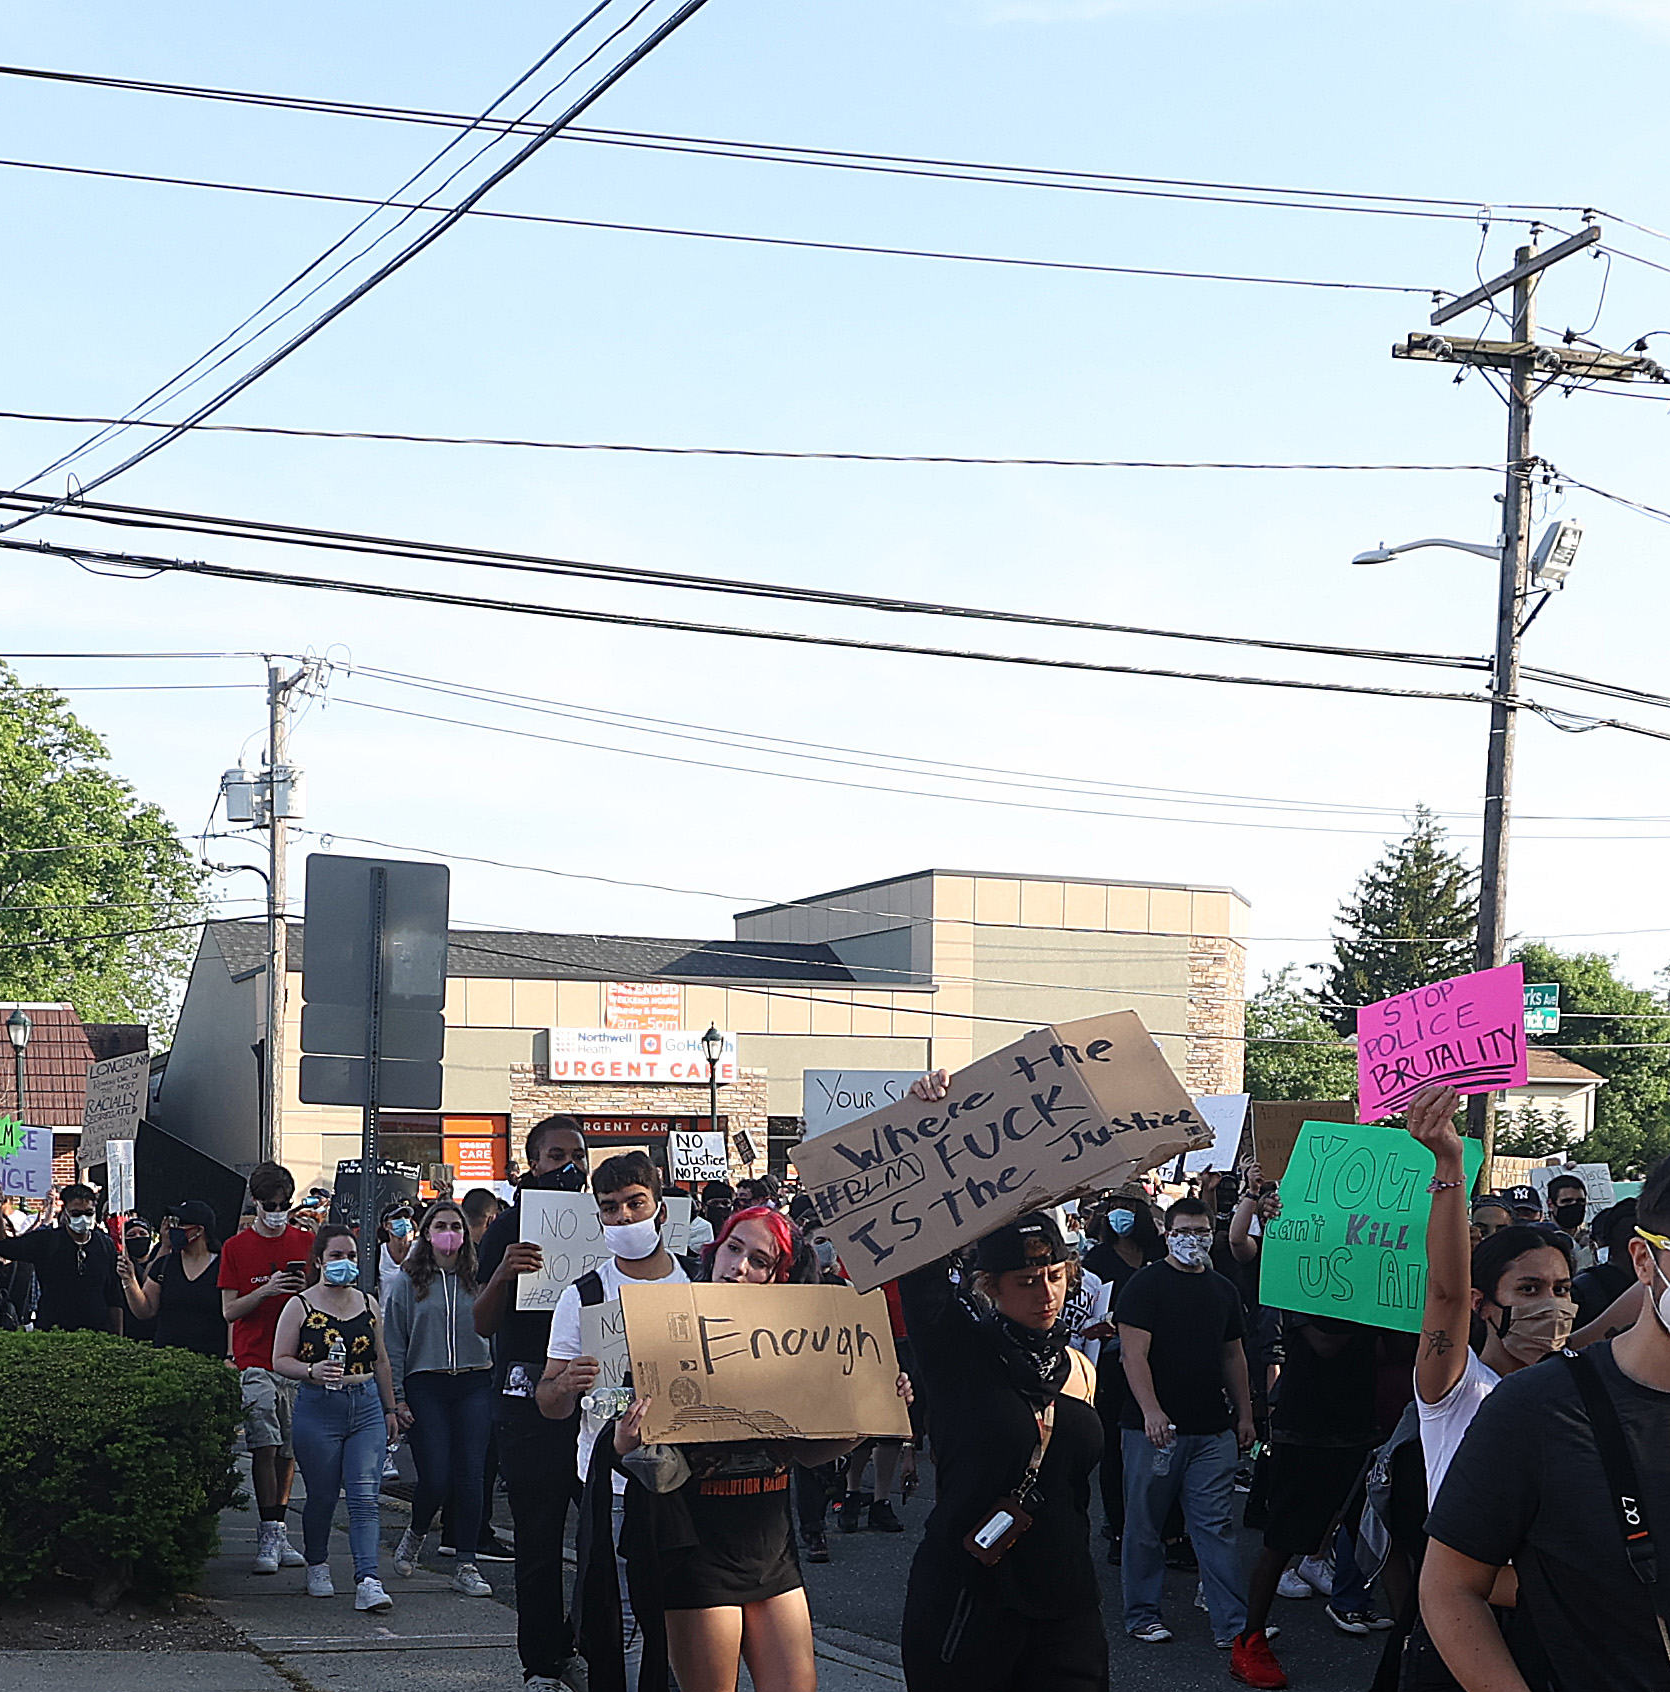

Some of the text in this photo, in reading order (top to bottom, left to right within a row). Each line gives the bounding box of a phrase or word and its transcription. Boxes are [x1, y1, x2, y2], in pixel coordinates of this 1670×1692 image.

[1383, 982, 1455, 1027] STOP
[578, 1032, 632, 1043] Northwell
[665, 1038, 734, 1052] GoHeh
[1364, 1002, 1480, 1062] POLICE
[578, 1044, 612, 1055] Health
[1369, 1023, 1518, 1096] BRUTALITY
[554, 1060, 658, 1077] URGENT
[85, 1090, 140, 1114] RACIALLY
[816, 1074, 875, 1115] YOUR
[583, 1121, 683, 1132] RGENT CARE
[833, 1090, 995, 1171] Where
[459, 1149, 491, 1159] CARE
[676, 1133, 703, 1149] NO
[815, 1084, 1087, 1219] #BLM FUCK
[677, 1148, 726, 1166] Justice
[675, 1167, 691, 1179] NO
[1304, 1135, 1421, 1212] YOU
[540, 1208, 578, 1241] NO
[1298, 1246, 1354, 1301] US
[698, 1315, 882, 1376] Enough
